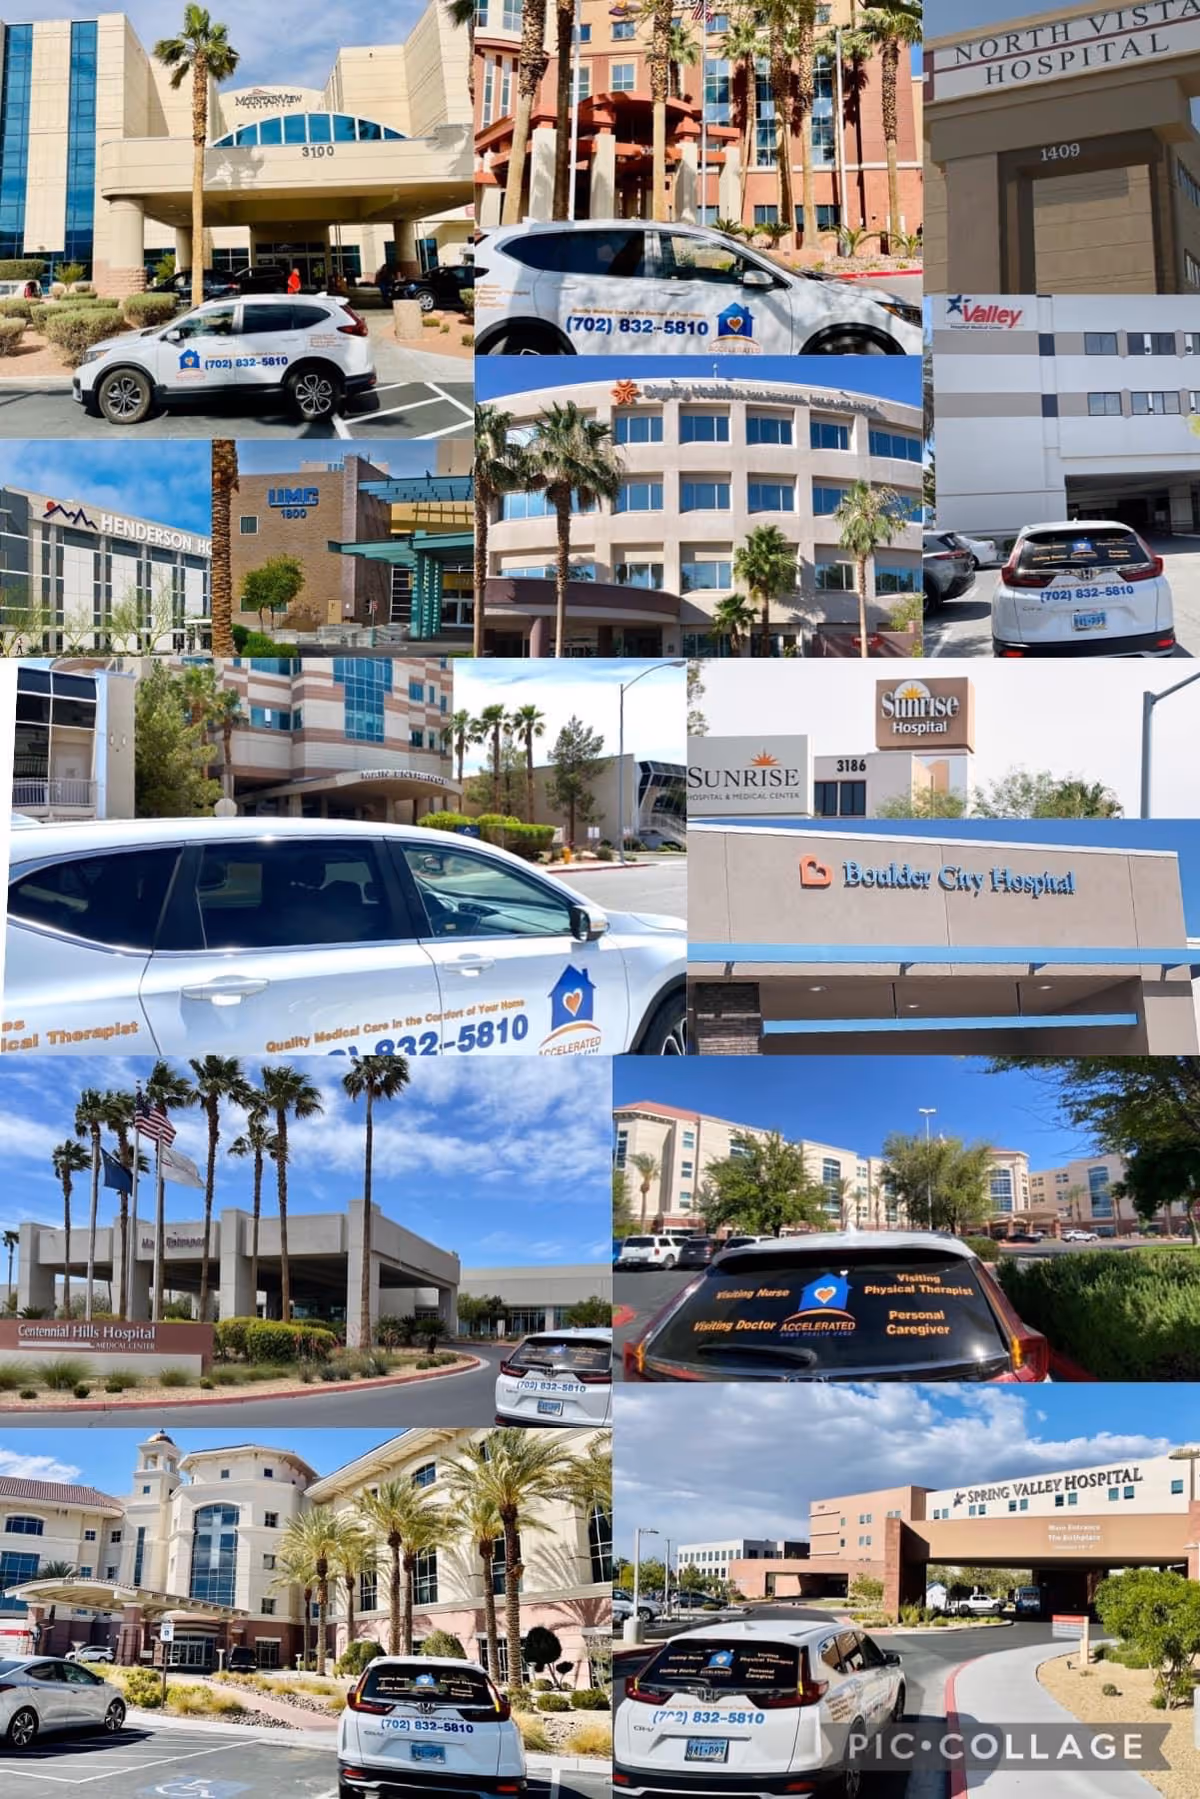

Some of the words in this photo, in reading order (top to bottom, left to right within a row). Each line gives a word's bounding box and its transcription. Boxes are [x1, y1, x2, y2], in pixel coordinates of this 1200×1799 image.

[955, 23, 1072, 64] NORTH
[1087, 0, 1200, 34] VISTA
[985, 33, 1170, 85] HOSPITAL
[302, 145, 335, 159] 3100
[1041, 142, 1080, 161] 1409
[962, 304, 1023, 328] Valley
[566, 315, 613, 335] (702)
[619, 318, 708, 336] 832-5810
[204, 359, 233, 370] (702)
[236, 356, 288, 368] 832-5810
[268, 487, 319, 508] UMC
[281, 509, 307, 519] 1800
[100, 513, 193, 551] HENDERSON
[1040, 590, 1072, 603] (702)
[1076, 585, 1134, 599] 832-5810
[881, 691, 960, 719] Sunrise
[892, 720, 947, 736] Hospital
[836, 758, 867, 773] 3186
[687, 766, 799, 789] SUNRISE
[732, 793, 768, 801] MEDICAL
[843, 860, 931, 890] Boulder
[938, 864, 984, 898] City
[989, 864, 1076, 899] Hospital
[46, 1020, 138, 1045] Therapist
[266, 1035, 311, 1053] Quality
[314, 1025, 360, 1043] Medical
[363, 1020, 389, 1034] Care
[392, 1018, 402, 1029] in
[405, 1015, 422, 1026] the
[425, 1008, 464, 1023] Comfort
[466, 1006, 476, 1017] of
[479, 1002, 499, 1014] Your
[500, 999, 525, 1010] Home
[897, 1273, 941, 1284] Visiting
[716, 1289, 754, 1300] Visiting
[756, 1288, 791, 1298] Nurse
[864, 1284, 915, 1296] Physical
[919, 1284, 974, 1296] Therapist
[889, 1310, 945, 1320] Personal
[18, 1323, 69, 1337] Centennial
[73, 1325, 99, 1338] Hills
[103, 1326, 156, 1341] Hospital
[694, 1321, 733, 1332] Visiting
[735, 1319, 777, 1331] Doctor
[779, 1321, 856, 1332] ACCELERATED
[886, 1323, 951, 1336] Caregiver
[967, 1487, 1010, 1503] SPRING
[1013, 1478, 1062, 1497] VALLEY
[1064, 1467, 1143, 1491] HOSPITAL
[381, 1719, 411, 1731] (702)
[414, 1720, 474, 1733] 832-5810
[692, 1711, 765, 1725] 832-5810
